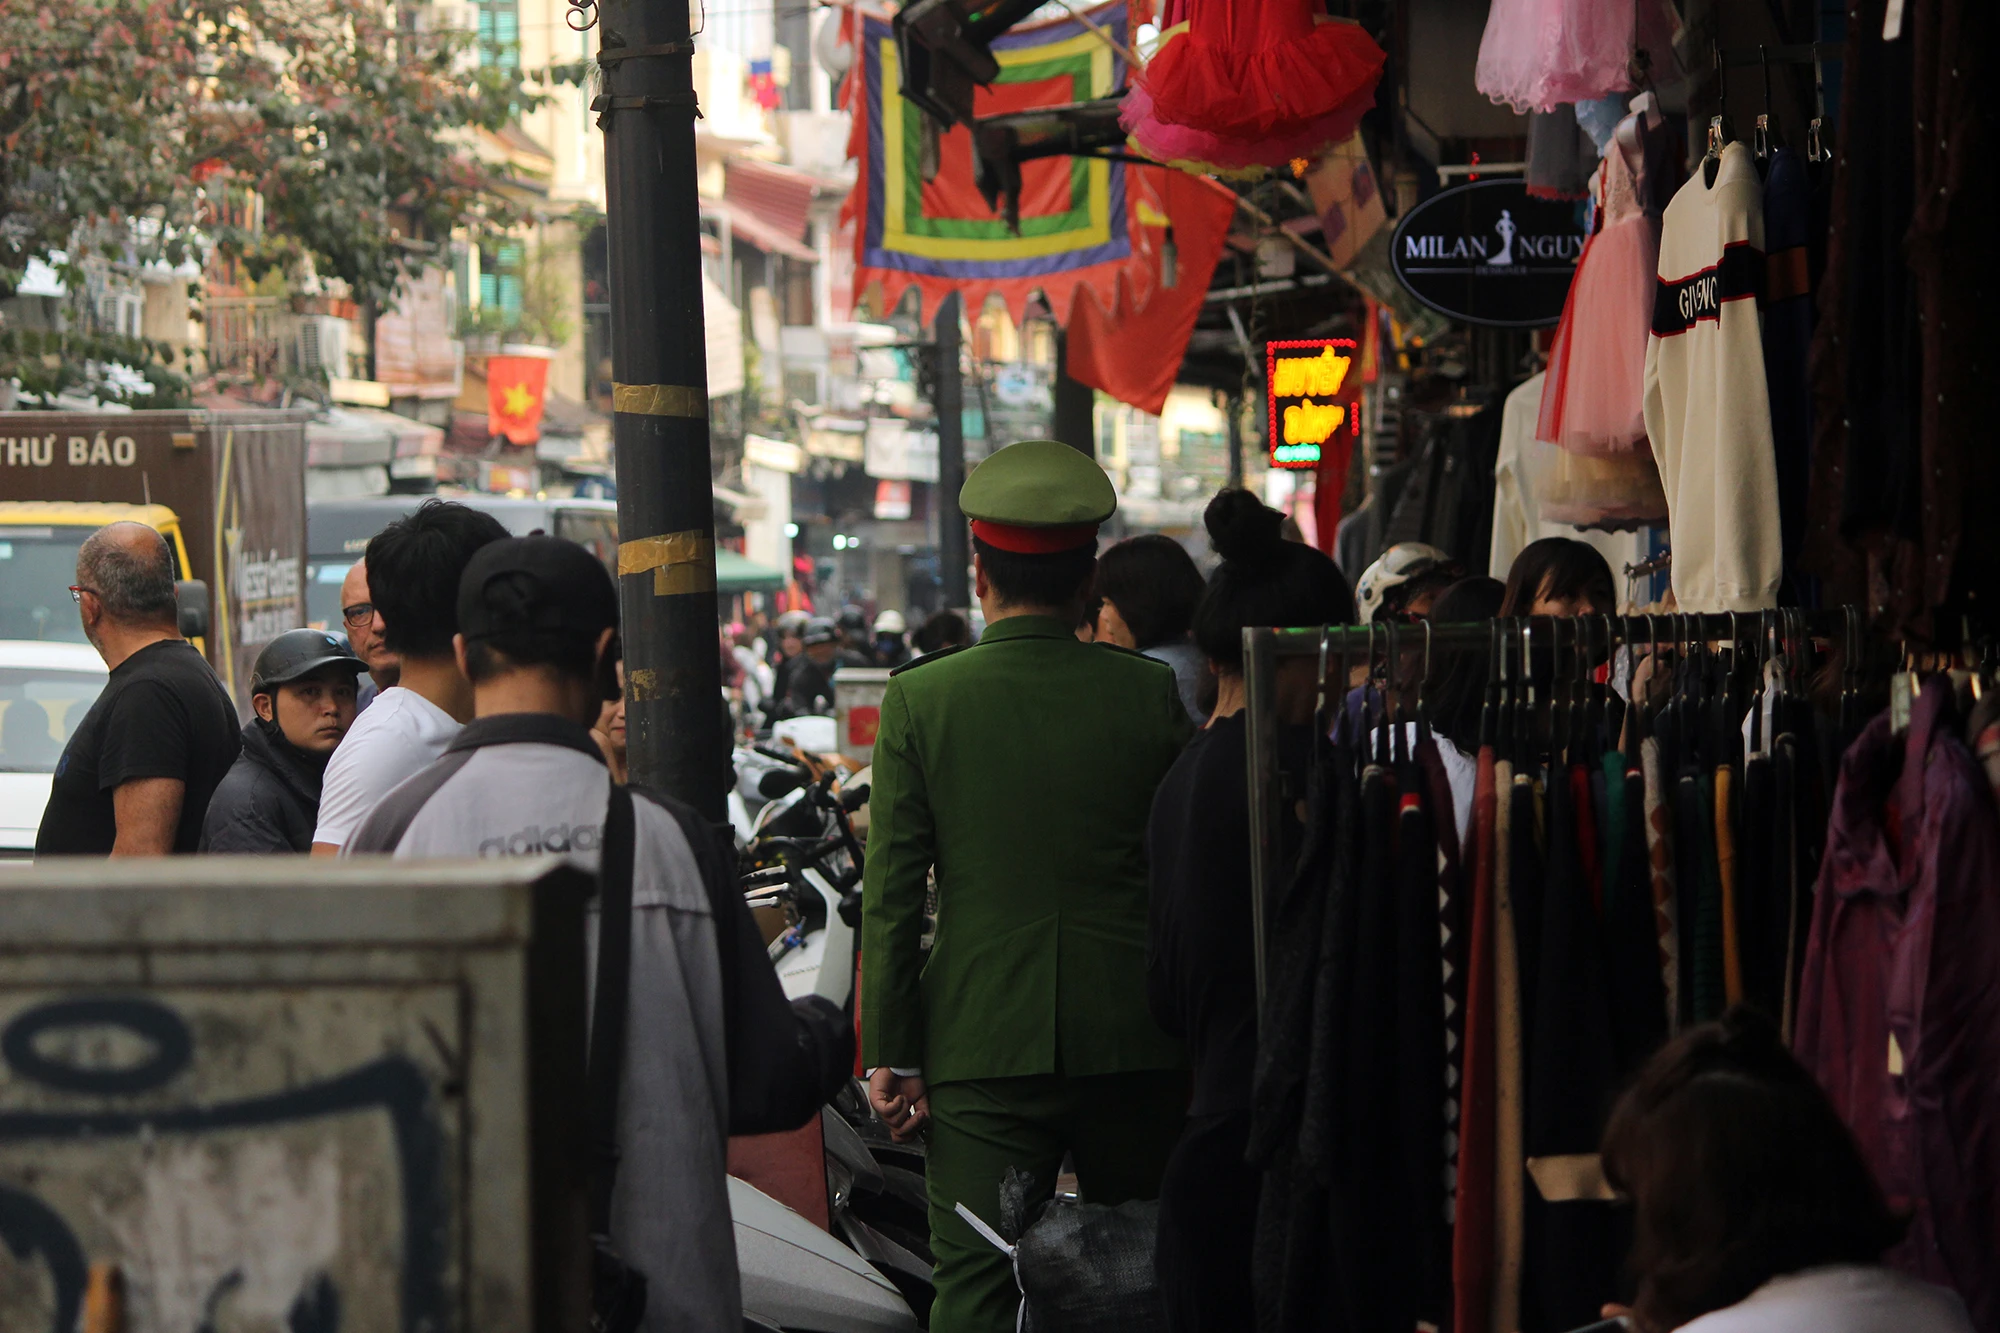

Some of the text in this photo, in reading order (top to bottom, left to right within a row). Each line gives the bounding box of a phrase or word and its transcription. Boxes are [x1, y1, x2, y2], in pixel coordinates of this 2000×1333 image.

[1405, 235, 1488, 259] MILAN
[68, 430, 136, 467] BÁO
[479, 821, 602, 859] adida
